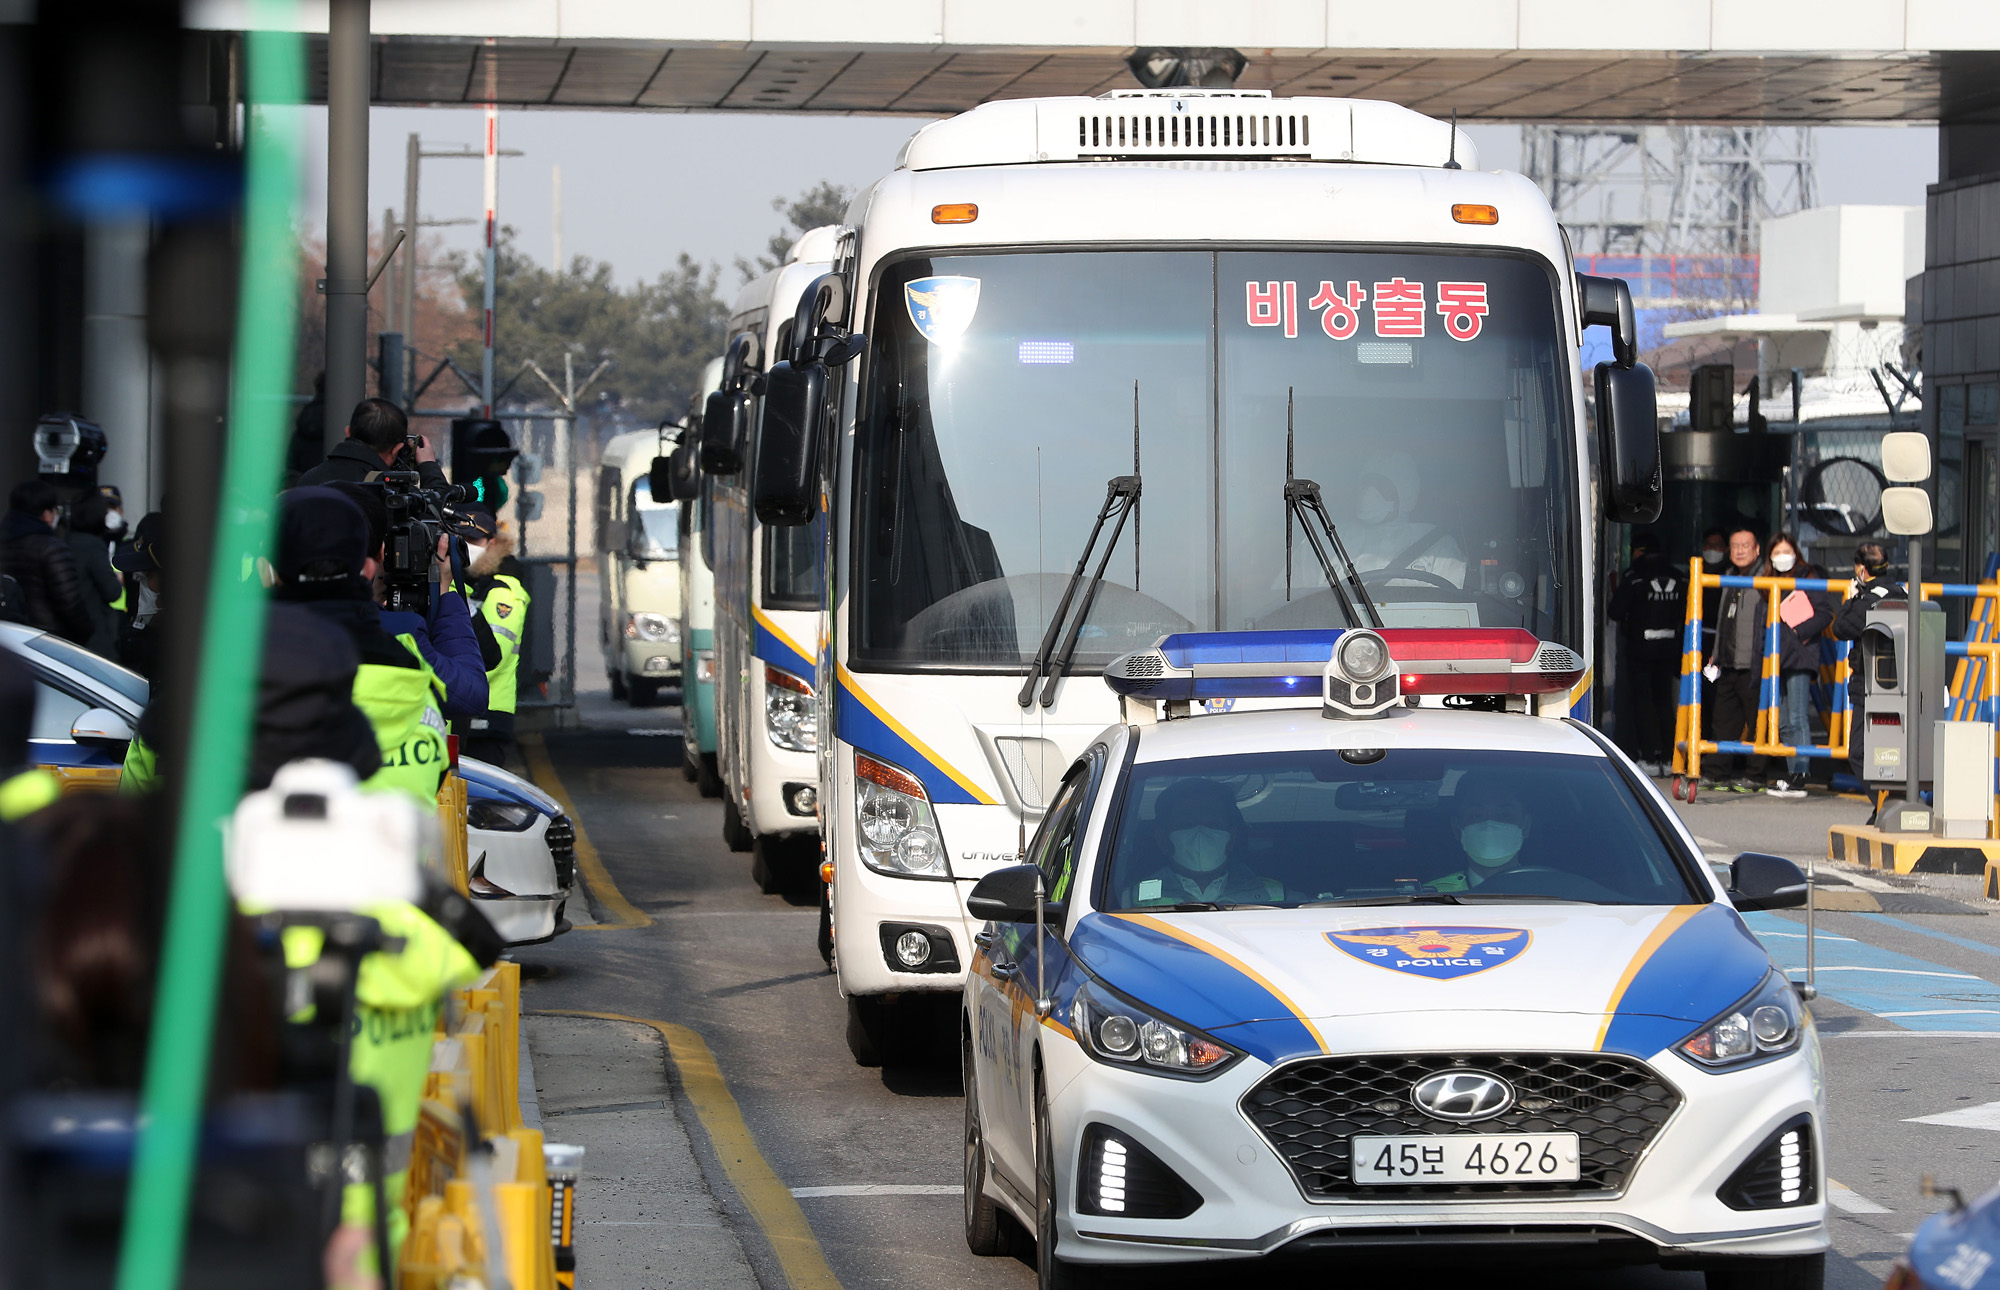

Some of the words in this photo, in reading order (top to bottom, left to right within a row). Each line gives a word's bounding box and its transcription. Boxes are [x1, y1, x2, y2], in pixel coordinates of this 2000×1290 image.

[1246, 277, 1489, 342] 비상출동
[1396, 958, 1483, 968] POLICE
[1373, 1143, 1444, 1177] 45보
[1464, 1141, 1558, 1176] 4626
